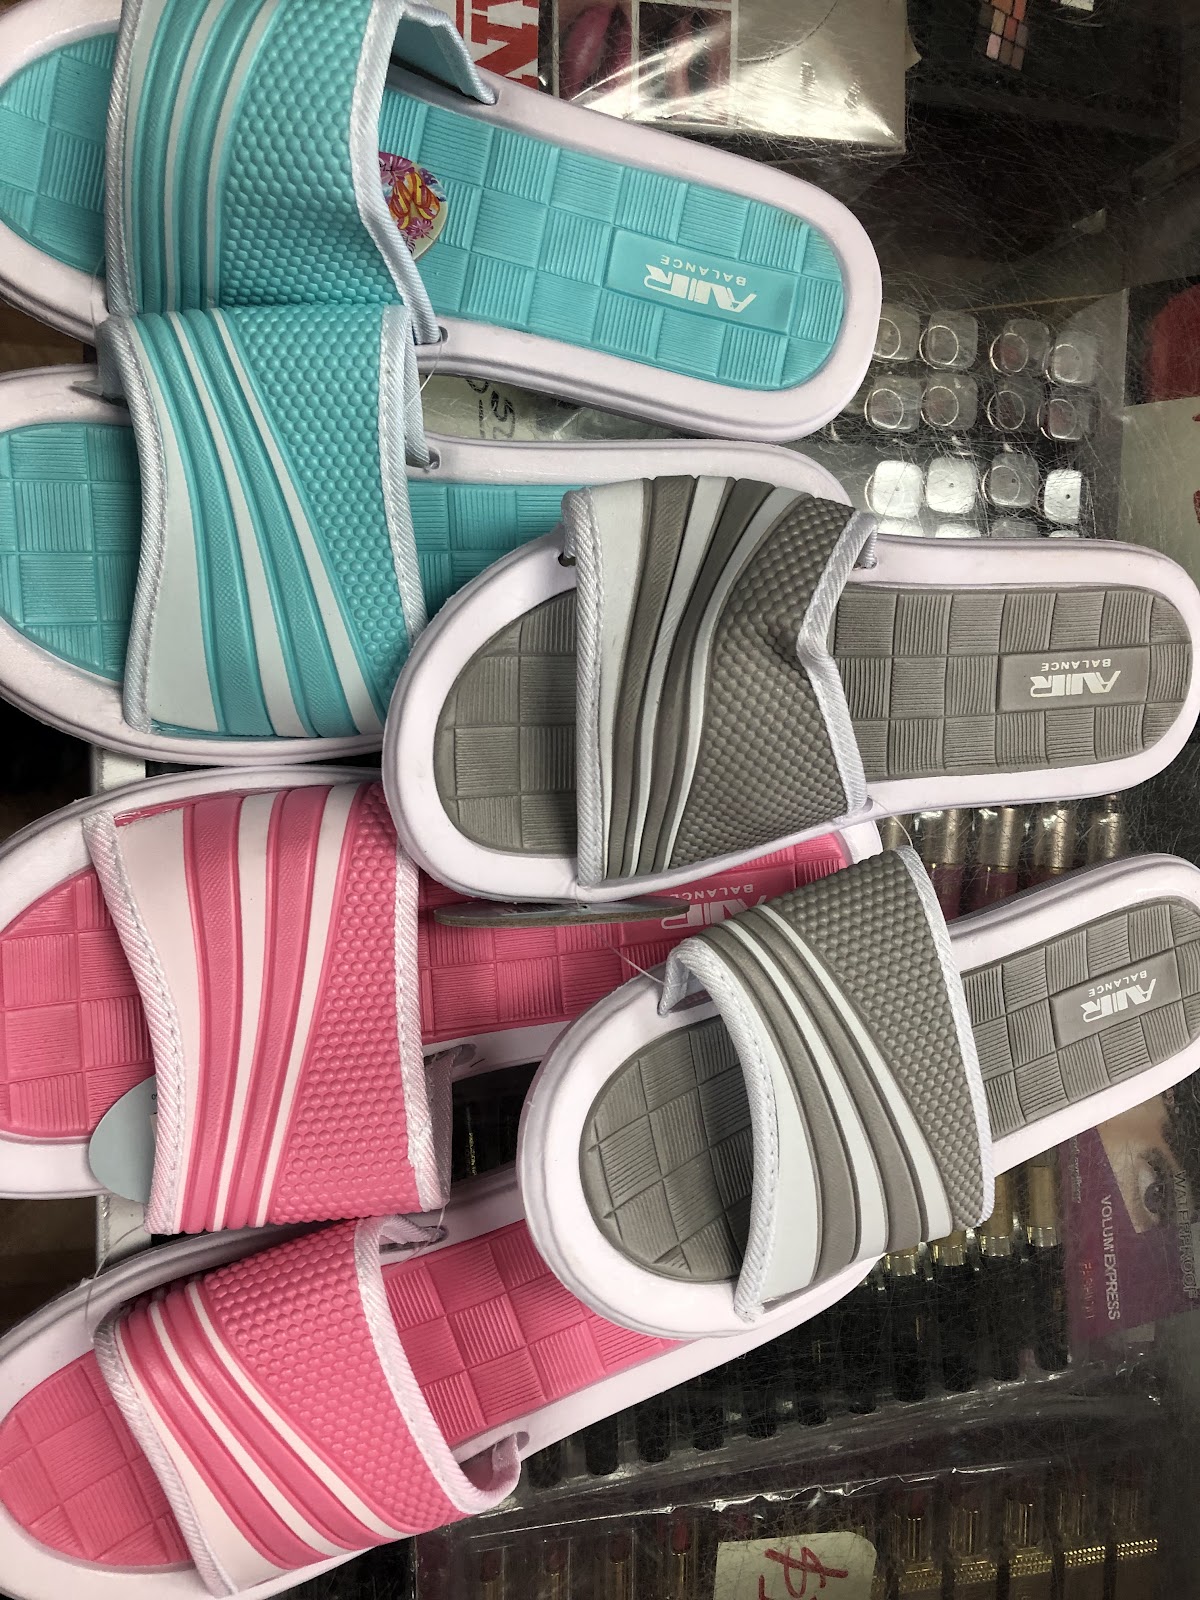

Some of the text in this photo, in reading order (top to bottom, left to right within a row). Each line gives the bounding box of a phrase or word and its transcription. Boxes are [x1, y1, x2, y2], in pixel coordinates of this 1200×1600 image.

[660, 254, 747, 287] BALANCE
[643, 264, 758, 313] AIR
[1041, 658, 1112, 672] BALANCE
[1030, 670, 1122, 698] AIR
[1088, 970, 1148, 998] BALANCE
[1080, 978, 1157, 1023] AIR
